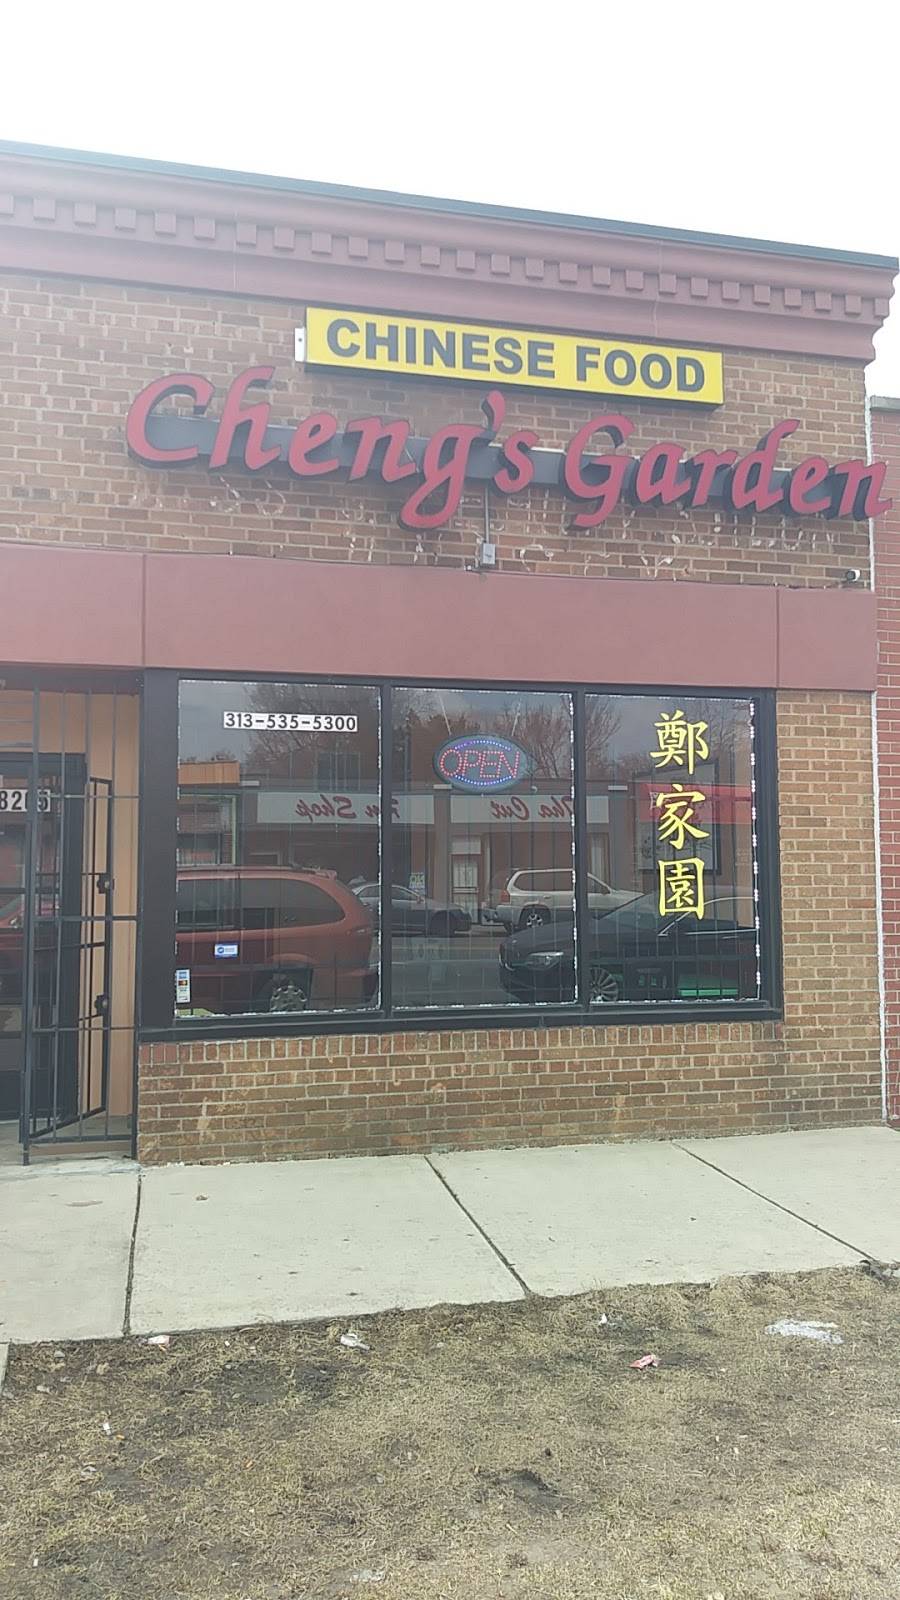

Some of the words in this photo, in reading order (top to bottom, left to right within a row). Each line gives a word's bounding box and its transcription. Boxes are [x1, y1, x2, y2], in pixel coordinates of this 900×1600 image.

[326, 318, 556, 380] CHINESE
[575, 344, 706, 393] FOOD
[126, 364, 541, 528] Cheng's
[564, 414, 893, 528] Garden
[225, 712, 357, 731] 313-535-5300
[439, 748, 520, 778] OPEN
[0, 790, 49, 811] 825
[650, 709, 710, 920] 鄭家園
